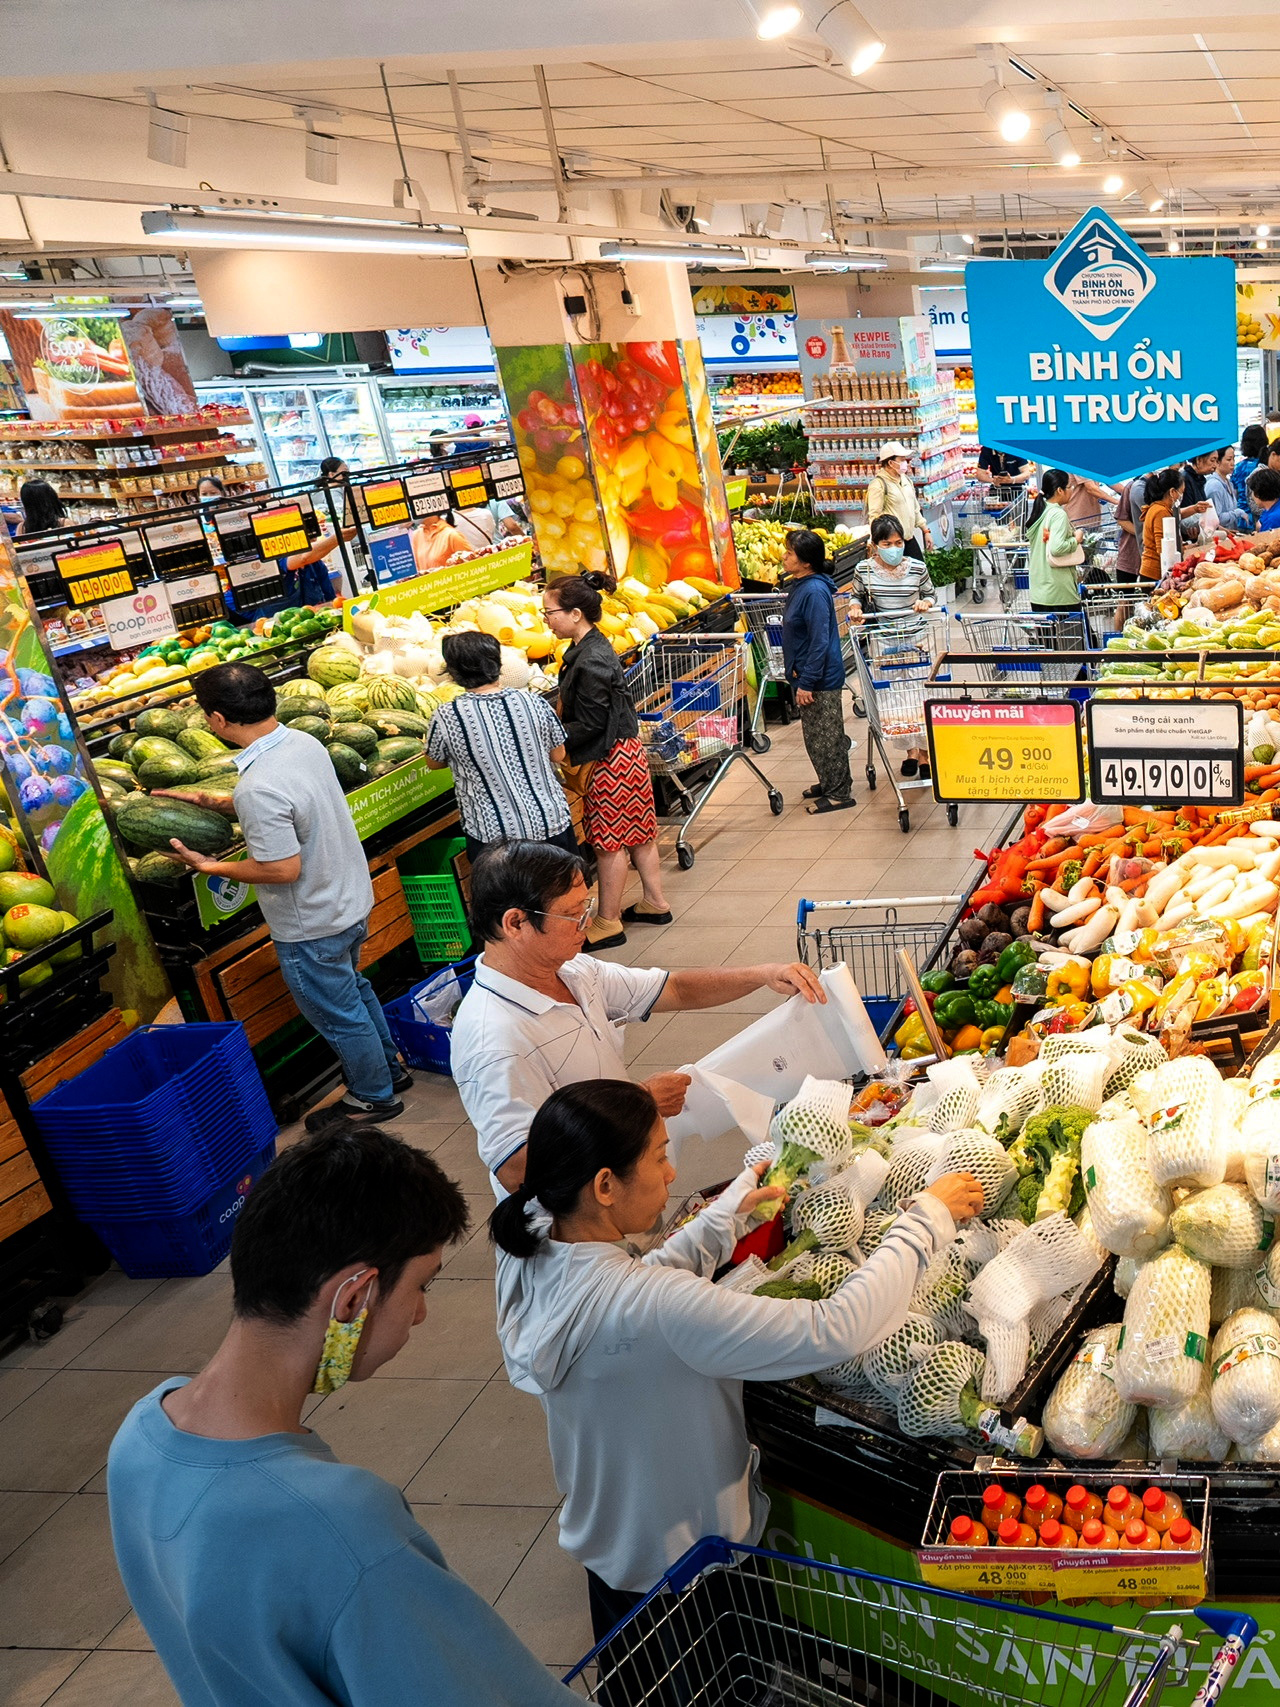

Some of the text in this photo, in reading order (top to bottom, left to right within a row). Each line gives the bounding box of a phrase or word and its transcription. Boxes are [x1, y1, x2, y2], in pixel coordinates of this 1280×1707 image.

[1082, 279, 1106, 289] BÌNH
[1072, 288, 1135, 299] THỊ TRƯỜNG
[853, 332, 890, 343] KEWPIE
[860, 350, 891, 359] Mè Rang
[1028, 337, 1182, 382] BÌNH ỔN
[996, 385, 1219, 431] THỊ TRƯỜNG
[995, 705, 1024, 719] mãi
[1132, 715, 1195, 726] Bông cải xanh
[1127, 727, 1145, 735] phẩm
[978, 747, 1052, 771] 49 900
[956, 774, 1069, 785] Mua 1 bịch ớt Palermo
[1105, 764, 1207, 790] 49.900
[968, 786, 1062, 798] tặng 1 hộp ớt 150g
[921, 1554, 955, 1563] Khuyến
[1057, 1558, 1091, 1567] Khuyến
[954, 1563, 971, 1571] pho
[977, 1571, 1003, 1585] 48
[1117, 1578, 1138, 1590] 48
